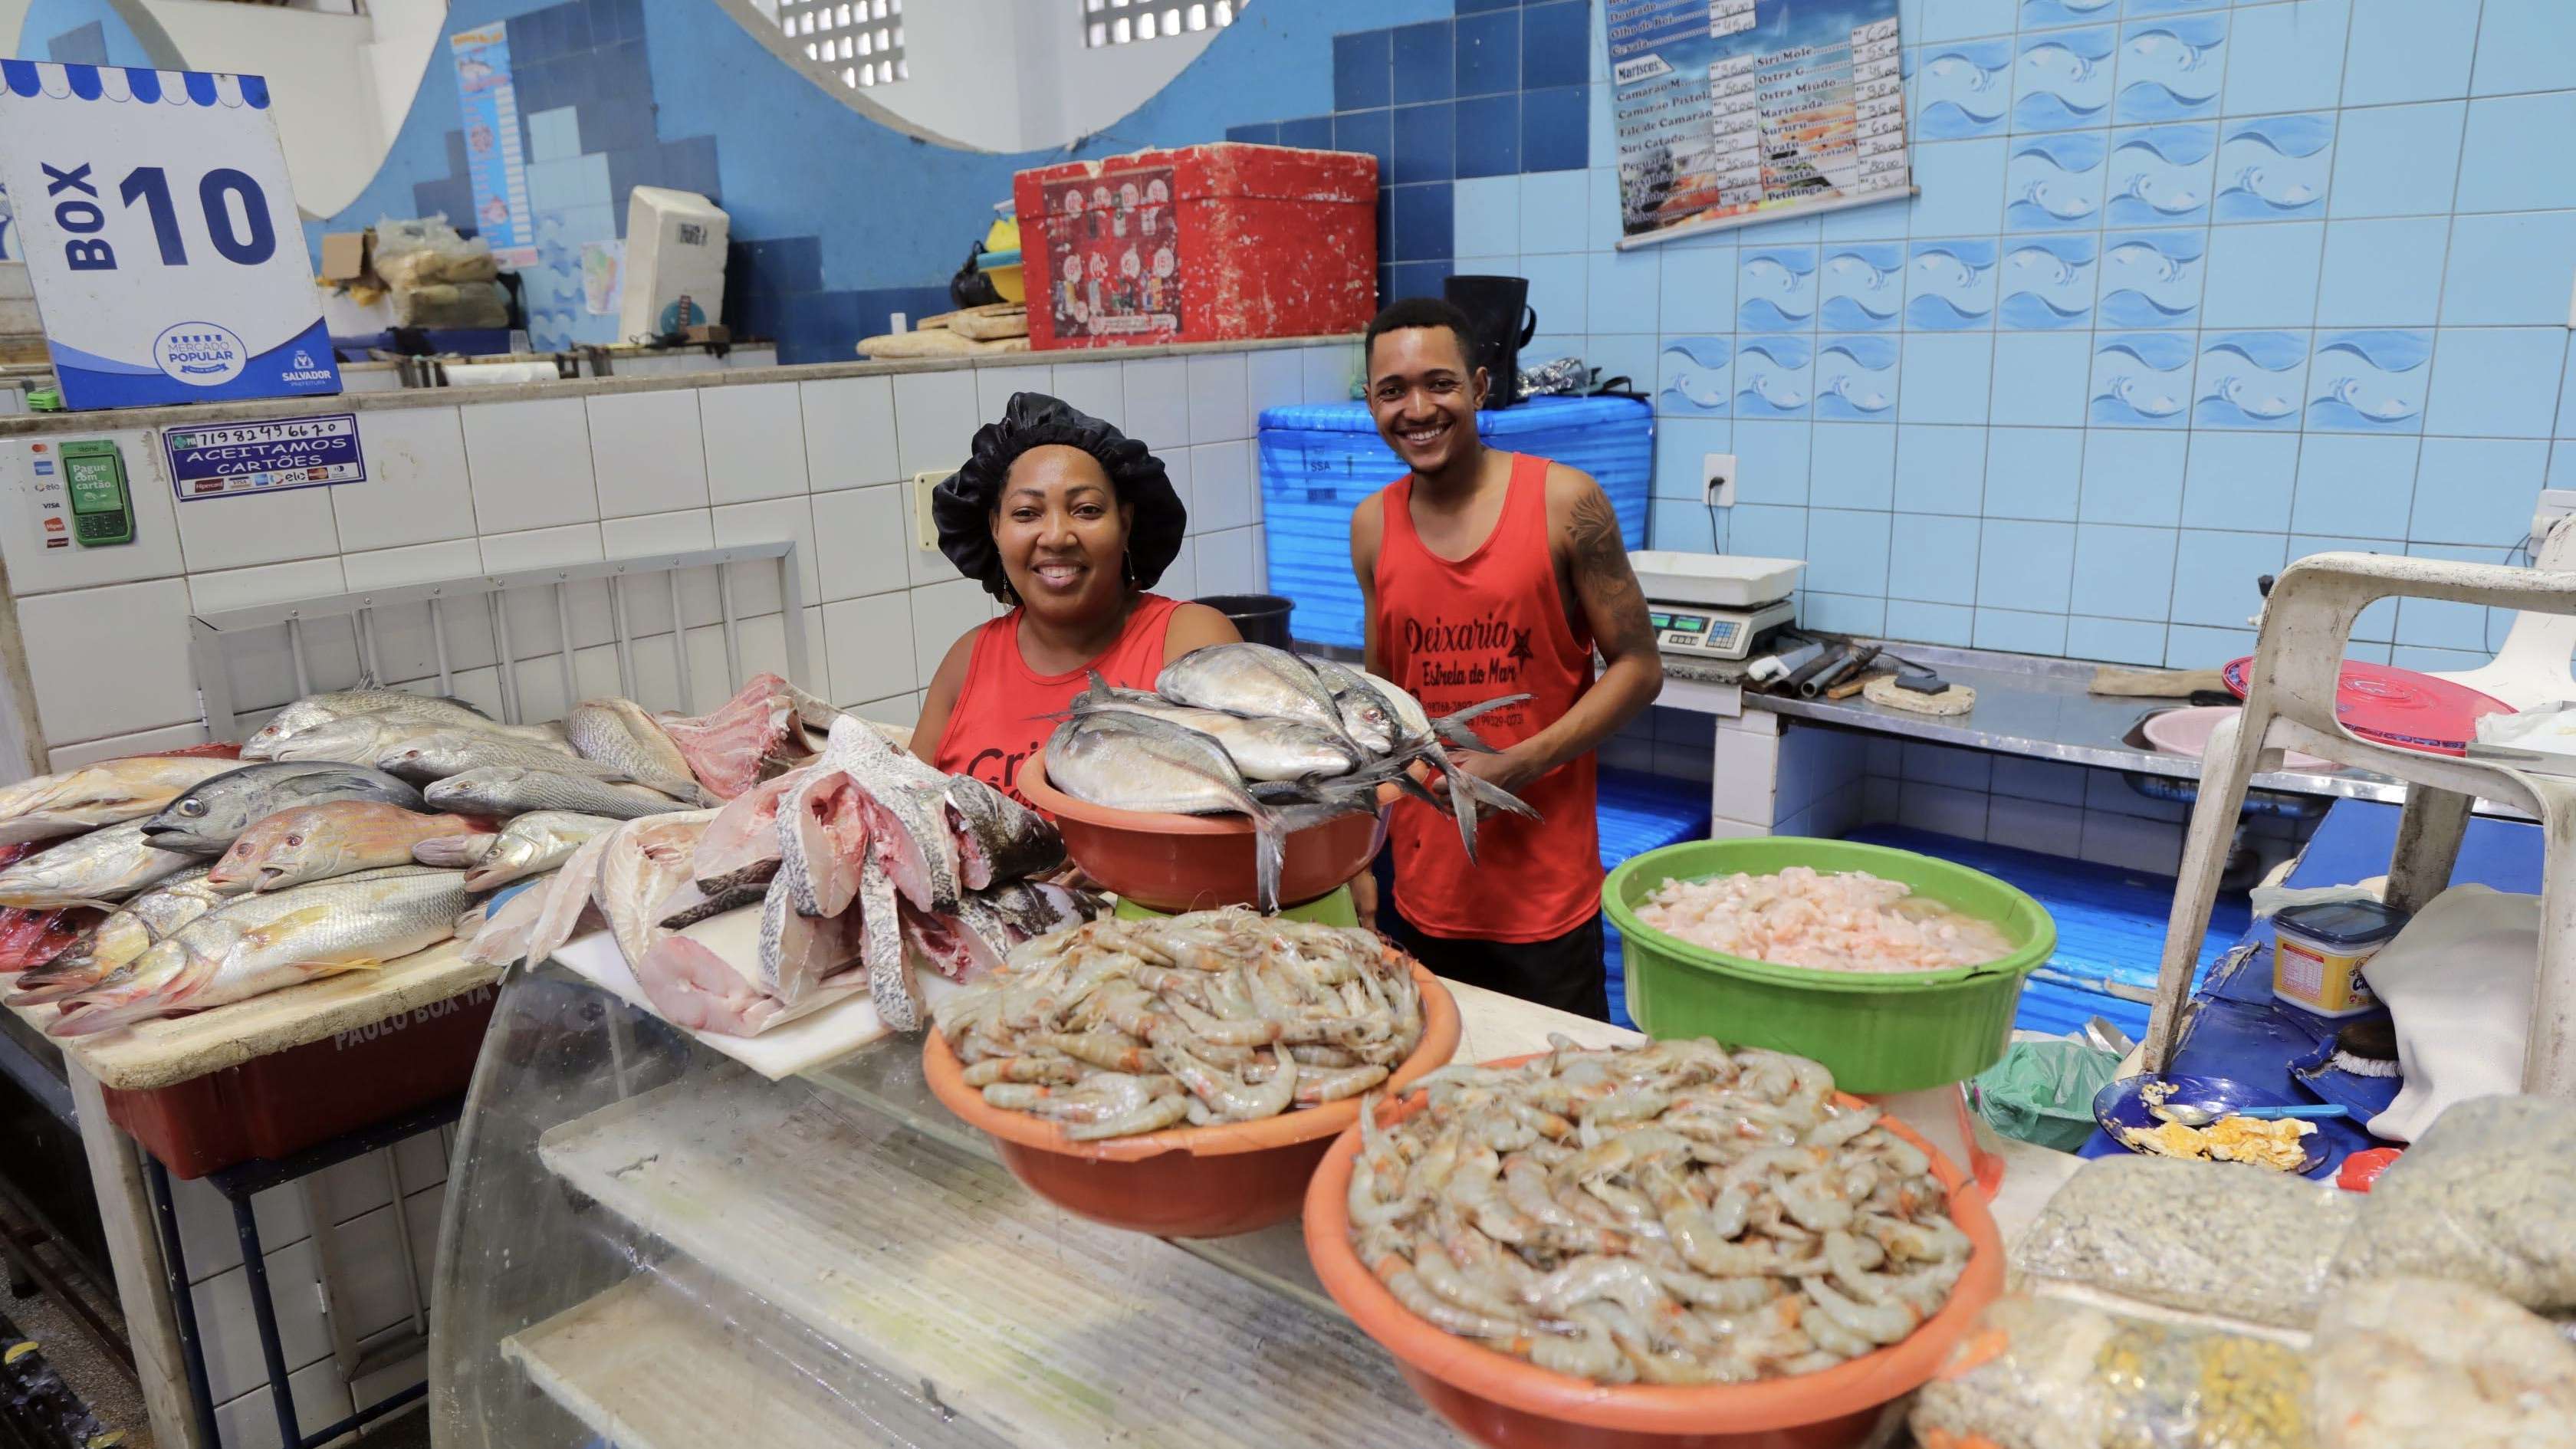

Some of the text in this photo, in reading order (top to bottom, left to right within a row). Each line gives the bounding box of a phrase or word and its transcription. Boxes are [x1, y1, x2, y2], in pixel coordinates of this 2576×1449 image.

[1757, 47, 1812, 68] Siri Mole
[1759, 71, 1792, 84] Ostra
[1760, 87, 1792, 102] Ostra
[1761, 100, 1823, 119] Mariscada
[1762, 122, 1808, 136] Sururu
[1622, 143, 1641, 153] Siri
[1766, 168, 1812, 186] Lagosta
[1767, 184, 1825, 202] Petitinga
[41, 162, 276, 271] BOX 10
[168, 342, 230, 353] MERCADO
[169, 351, 233, 363] POPULAR
[281, 370, 331, 382] SALVADOR
[186, 438, 347, 462] ACEITAMOS
[73, 465, 107, 475] Pague
[216, 455, 323, 475] CARTÕES
[285, 468, 306, 480] elo
[1422, 657, 1517, 687] Estrela do Mar
[333, 1011, 408, 1051] PAULO
[414, 997, 460, 1024] BOX
